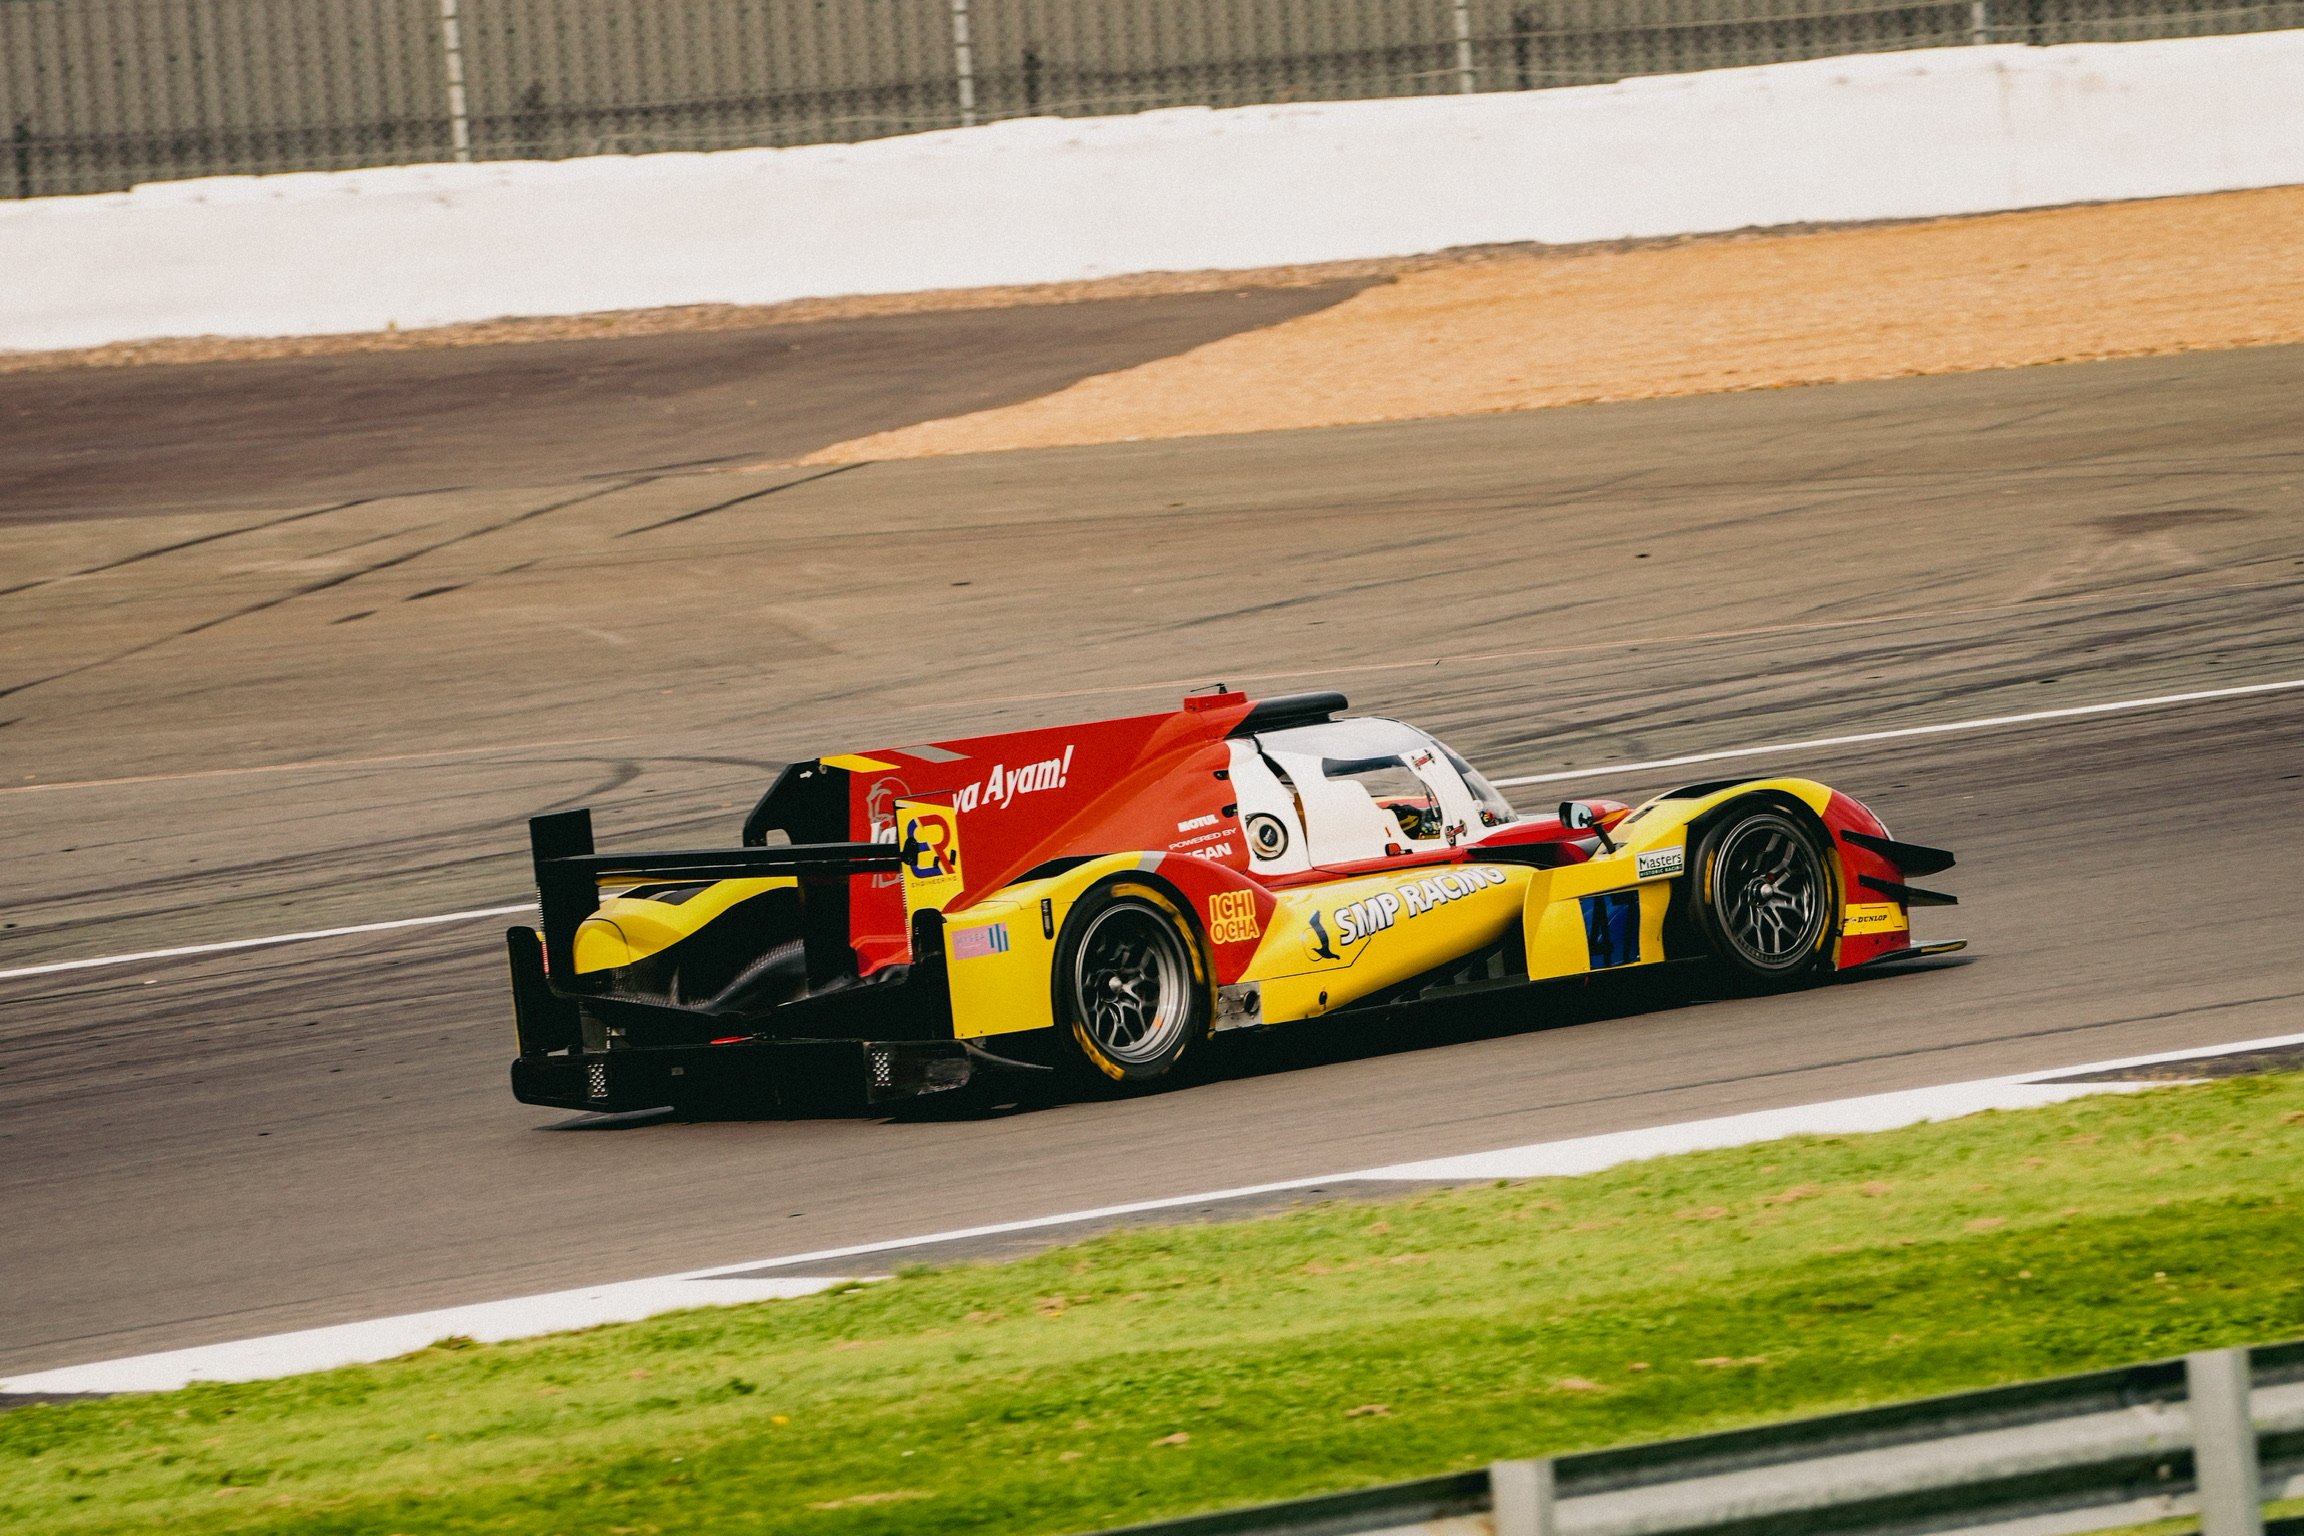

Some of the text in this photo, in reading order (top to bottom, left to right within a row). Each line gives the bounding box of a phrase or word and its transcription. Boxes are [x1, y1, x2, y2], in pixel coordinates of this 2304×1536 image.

[981, 745, 1074, 809] Ayam!
[1177, 814, 1219, 832] MOTUL
[1168, 828, 1237, 850] POWERED BY
[1183, 842, 1233, 860] SAN
[1639, 853, 1681, 869] Masters
[1209, 889, 1256, 923] ICHI
[1334, 866, 1506, 945] SMP RACING
[1857, 914, 1888, 923] DUNLOP
[1210, 919, 1260, 944] OCHA
